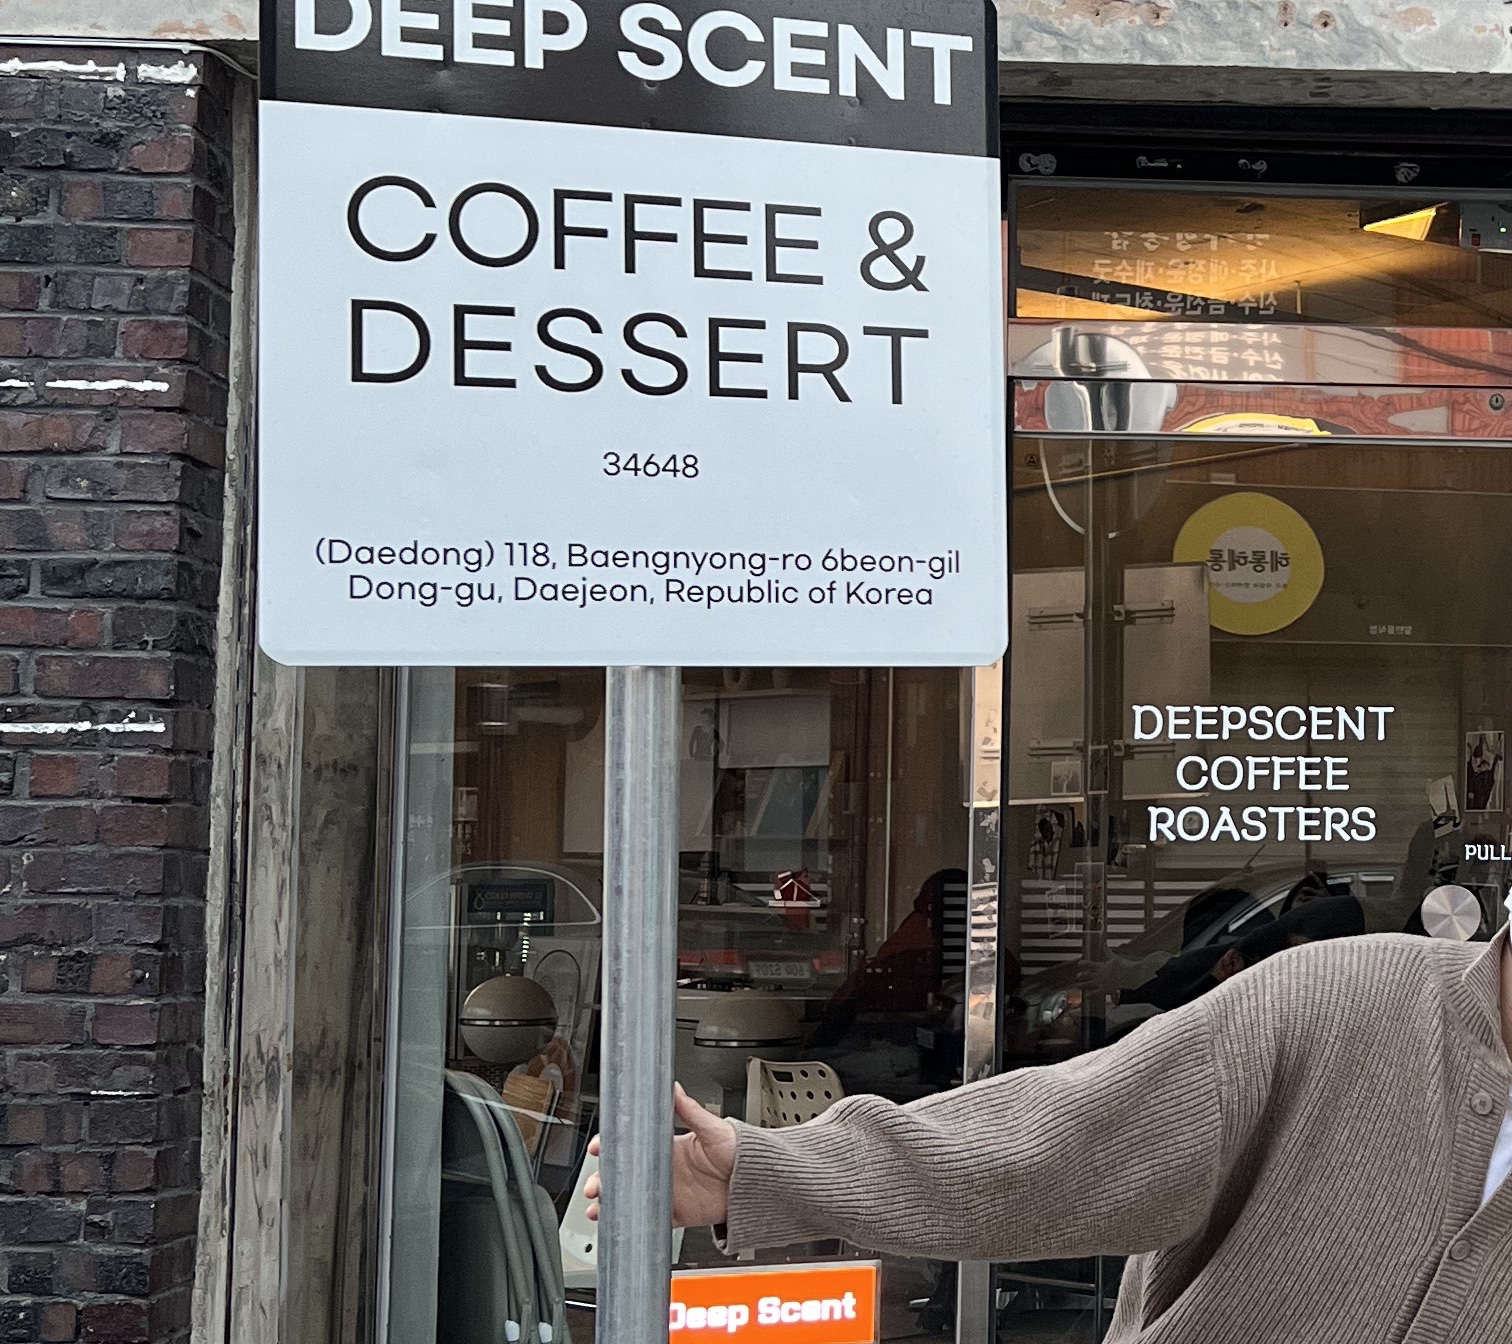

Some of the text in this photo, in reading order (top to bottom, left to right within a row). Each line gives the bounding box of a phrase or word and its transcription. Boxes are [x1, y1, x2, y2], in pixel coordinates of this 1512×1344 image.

[617, 2, 974, 106] SCENT
[347, 175, 931, 293] COFFEE &
[349, 297, 931, 406] DESSERT
[603, 452, 700, 480] 34648
[315, 536, 960, 580] (Daedong) 118, Baengnyong-ro 6beon-gil
[349, 574, 934, 609] Dong-gu, Daejeon, Republic of Korea
[1131, 705, 1395, 742] DEEPSCENT
[1176, 755, 1350, 791] COFFEE
[1147, 806, 1377, 842] ROASTERS
[1464, 843, 1512, 861] PULL
[669, 1291, 857, 1334] Deep Scent
